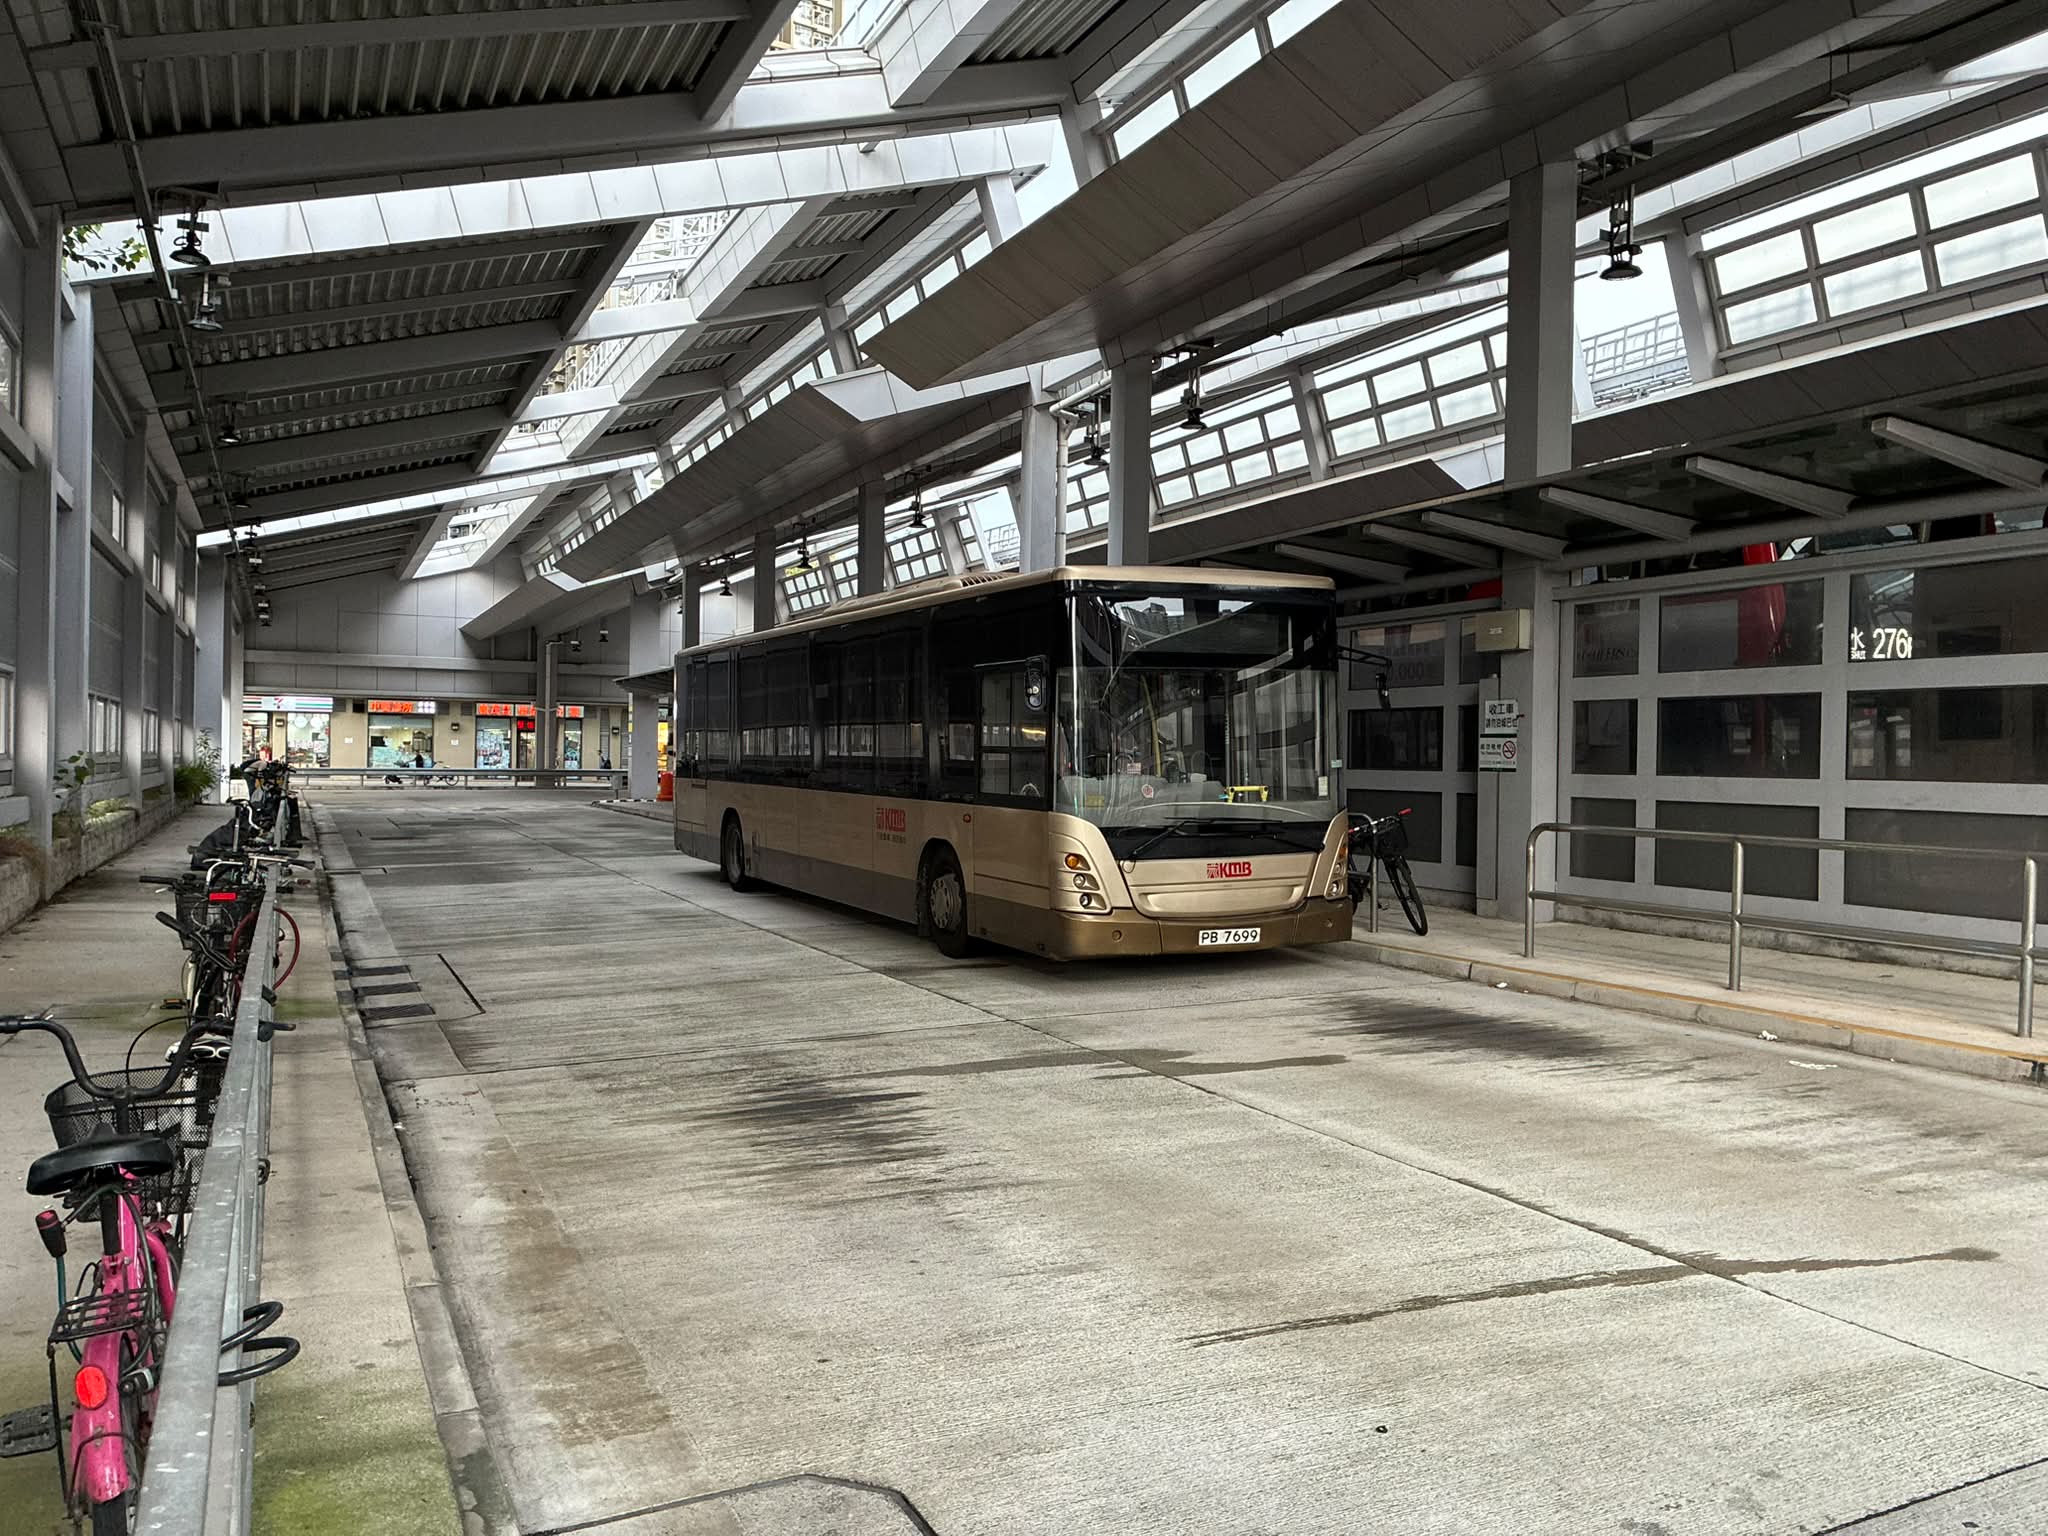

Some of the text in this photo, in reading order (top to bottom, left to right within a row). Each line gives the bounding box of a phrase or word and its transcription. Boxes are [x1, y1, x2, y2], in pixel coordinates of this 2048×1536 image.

[1488, 703, 1514, 715] 收工車
[1219, 861, 1252, 879] KMB
[1201, 929, 1258, 944] PB 7699
